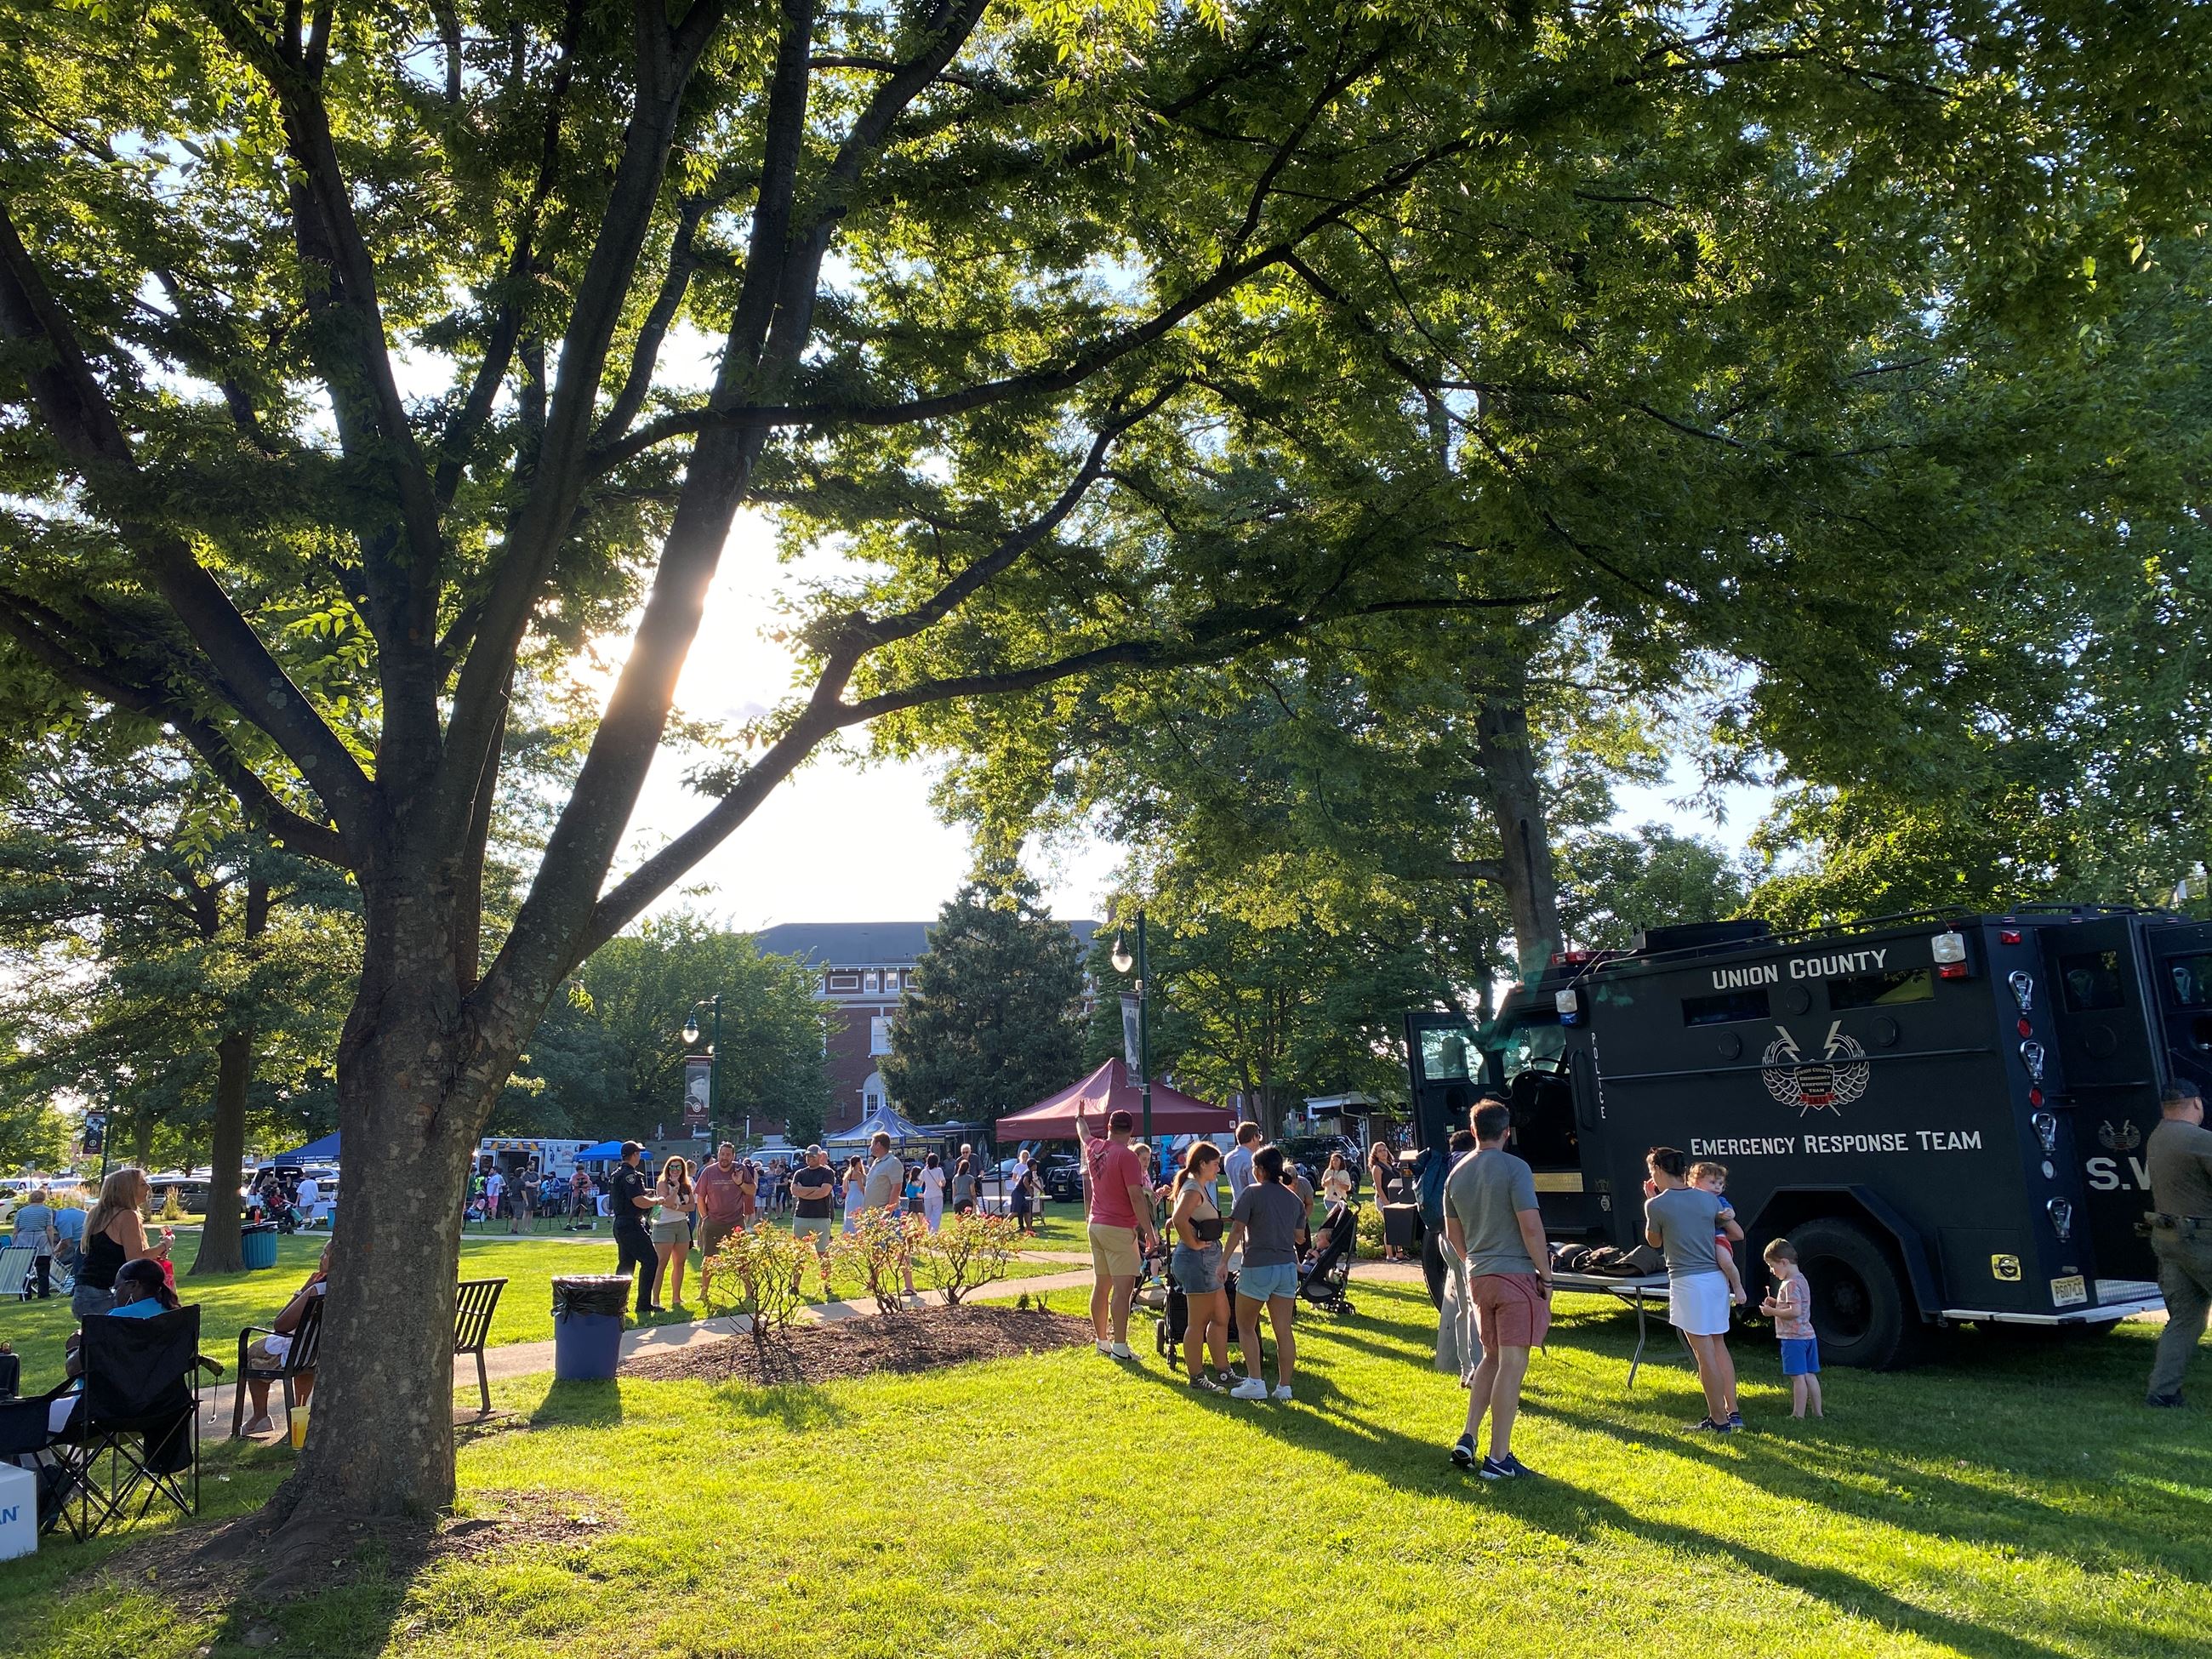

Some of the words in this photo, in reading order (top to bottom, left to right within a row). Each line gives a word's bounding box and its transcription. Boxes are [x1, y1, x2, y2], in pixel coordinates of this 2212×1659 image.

[1712, 964, 1779, 990] UNION
[1789, 948, 1888, 979] COUNTY
[1591, 1032, 1606, 1120] POLICE
[1690, 1136, 1795, 1156] EMERGENCY
[1804, 1132, 1908, 1154] RESPONSE
[1916, 1130, 1982, 1150] TEAM
